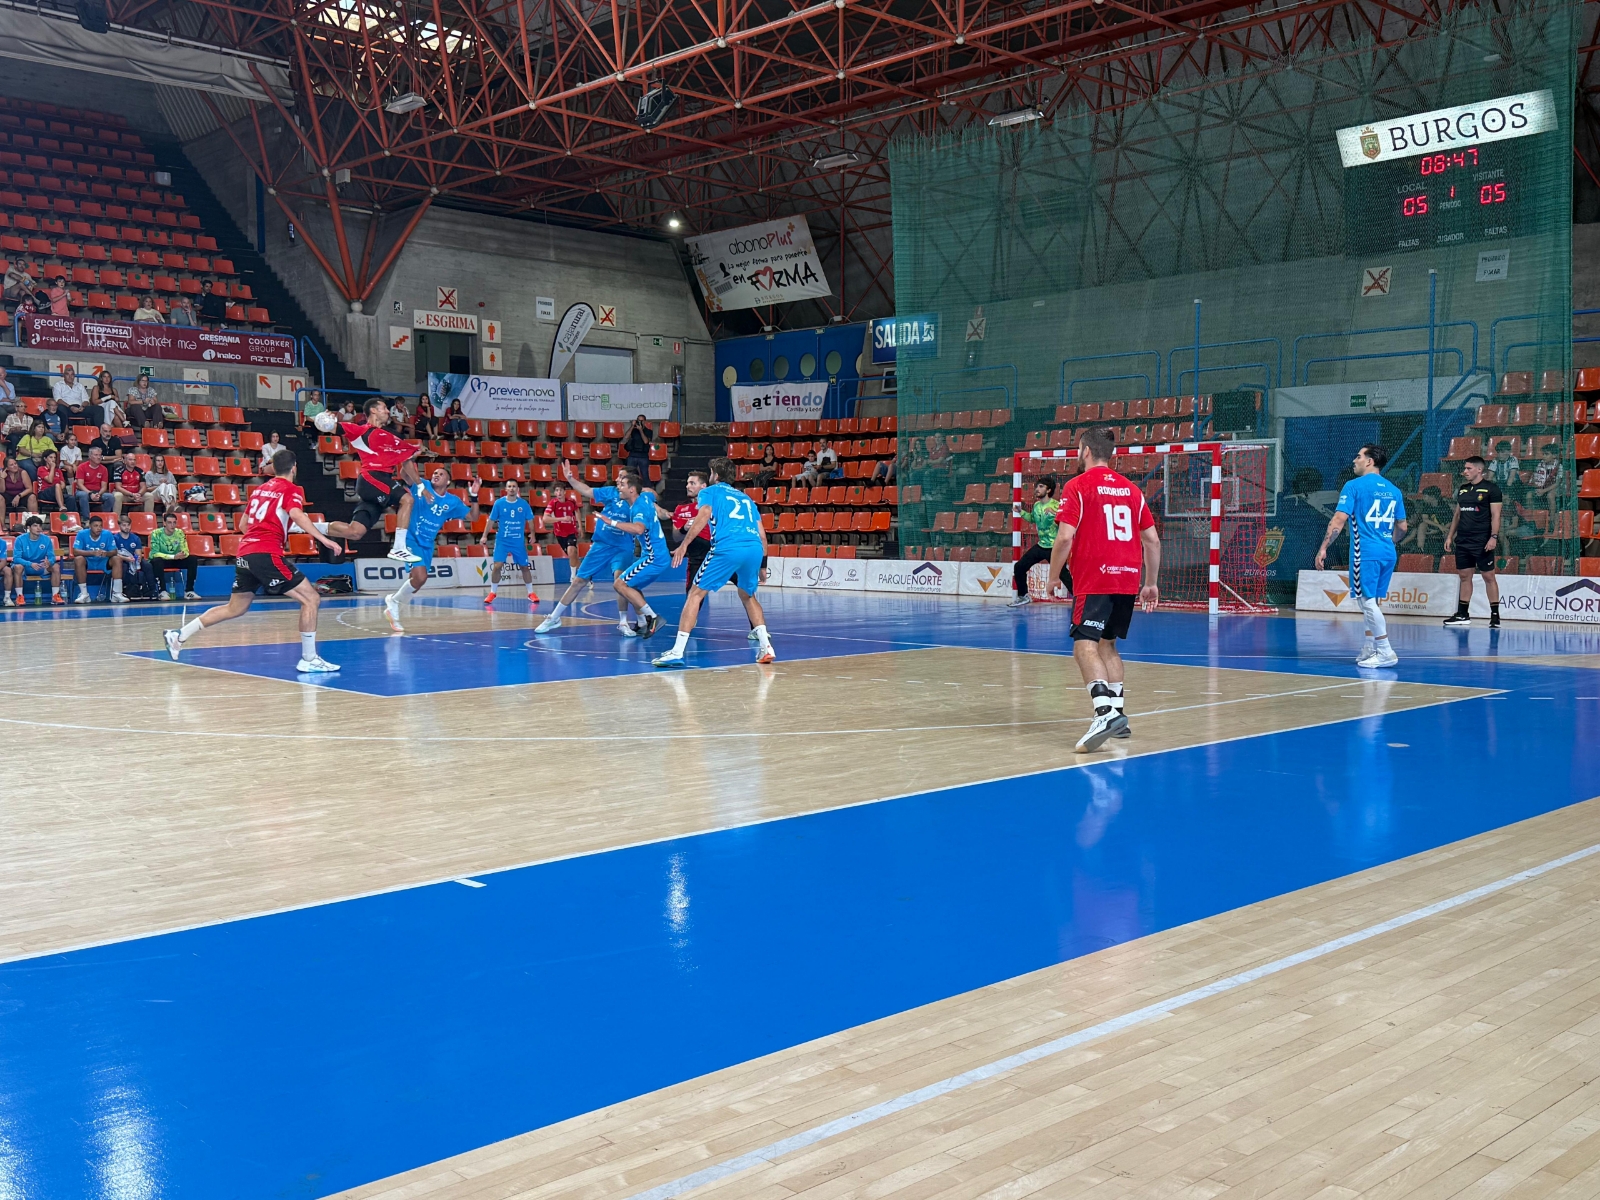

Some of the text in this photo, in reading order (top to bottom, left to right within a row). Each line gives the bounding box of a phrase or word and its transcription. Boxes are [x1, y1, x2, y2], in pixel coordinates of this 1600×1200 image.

[1388, 102, 1528, 152] BURGOS
[1397, 182, 1428, 194] LOCAL
[1480, 182, 1507, 205] 05
[1403, 195, 1428, 216] 05
[33, 318, 75, 330] geotiles
[425, 313, 476, 330] ESGRIMA
[85, 325, 129, 337] PROPAMSA
[874, 320, 920, 349] SALIDA
[86, 339, 130, 351] ARGENTA
[199, 333, 241, 344] GRESPANIA
[248, 338, 290, 348] COLORKER
[248, 345, 276, 354] GROUP
[488, 386, 556, 397] prevennova
[752, 390, 823, 409] atiendo
[1097, 486, 1131, 497] RODRIGO
[247, 498, 270, 524] 24
[510, 509, 515, 518] 8
[725, 495, 754, 523] 21
[1365, 499, 1397, 530] 44
[1103, 504, 1133, 541] 19
[878, 573, 942, 587] PARQUENORTE
